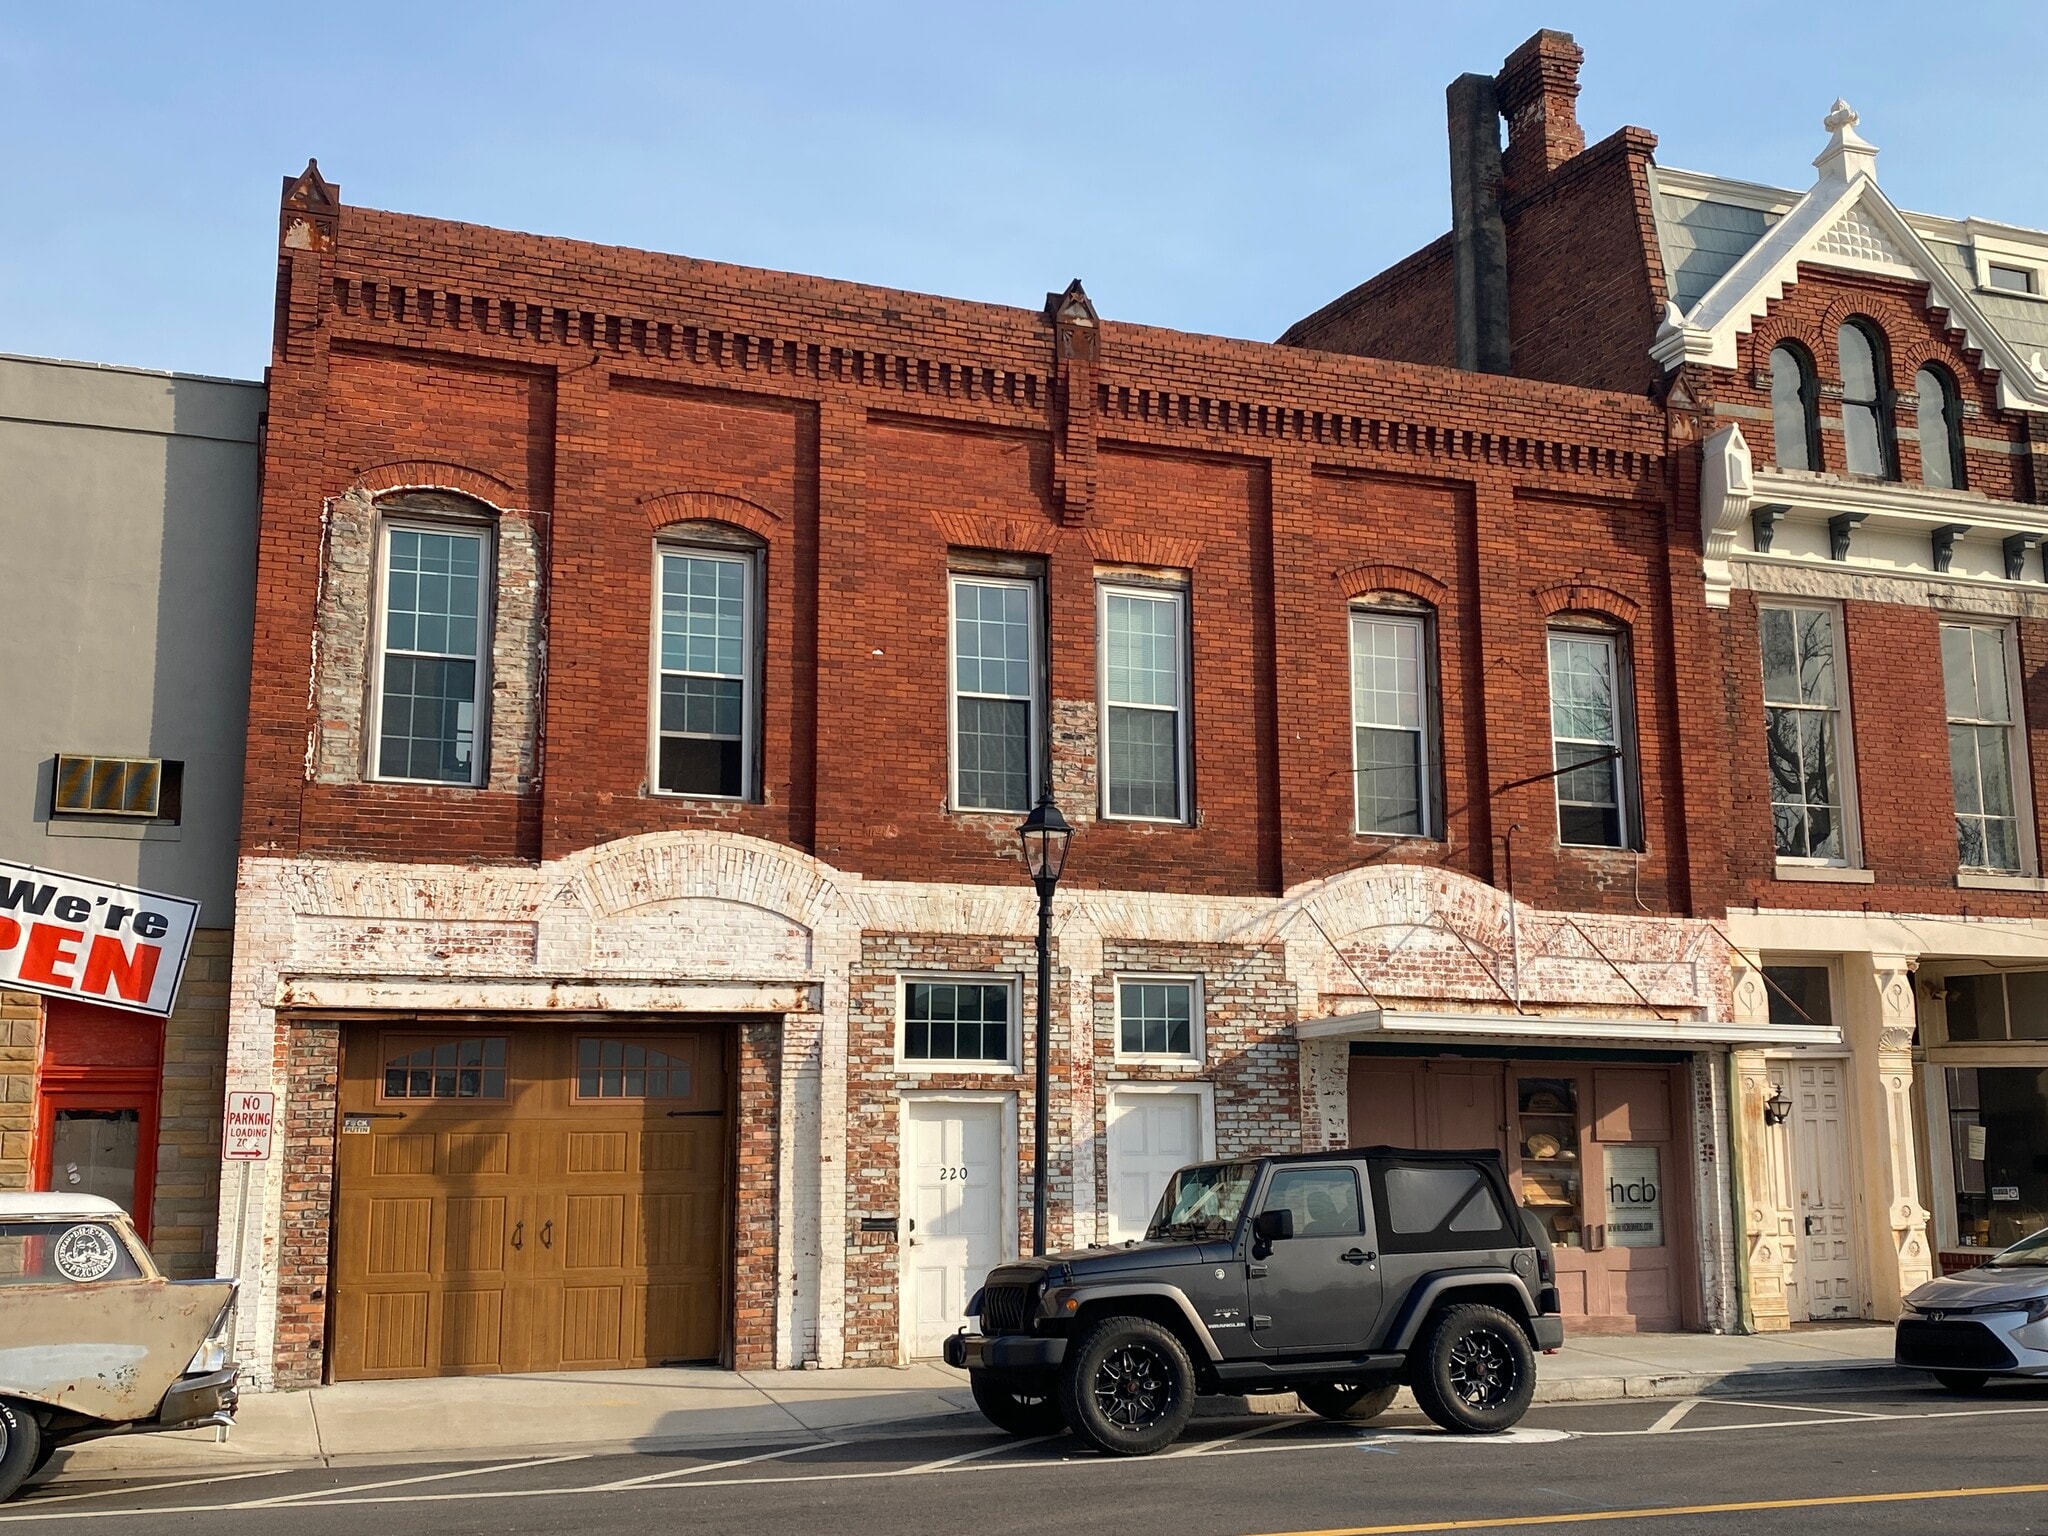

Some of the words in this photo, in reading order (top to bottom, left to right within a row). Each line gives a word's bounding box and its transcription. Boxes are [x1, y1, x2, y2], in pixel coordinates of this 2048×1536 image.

[0, 876, 169, 938] We're
[242, 1097, 260, 1110] NO
[229, 1112, 271, 1125] PARKING
[230, 1128, 267, 1138] LOADING
[940, 1167, 968, 1181] 220
[1610, 1176, 1656, 1203] hcb
